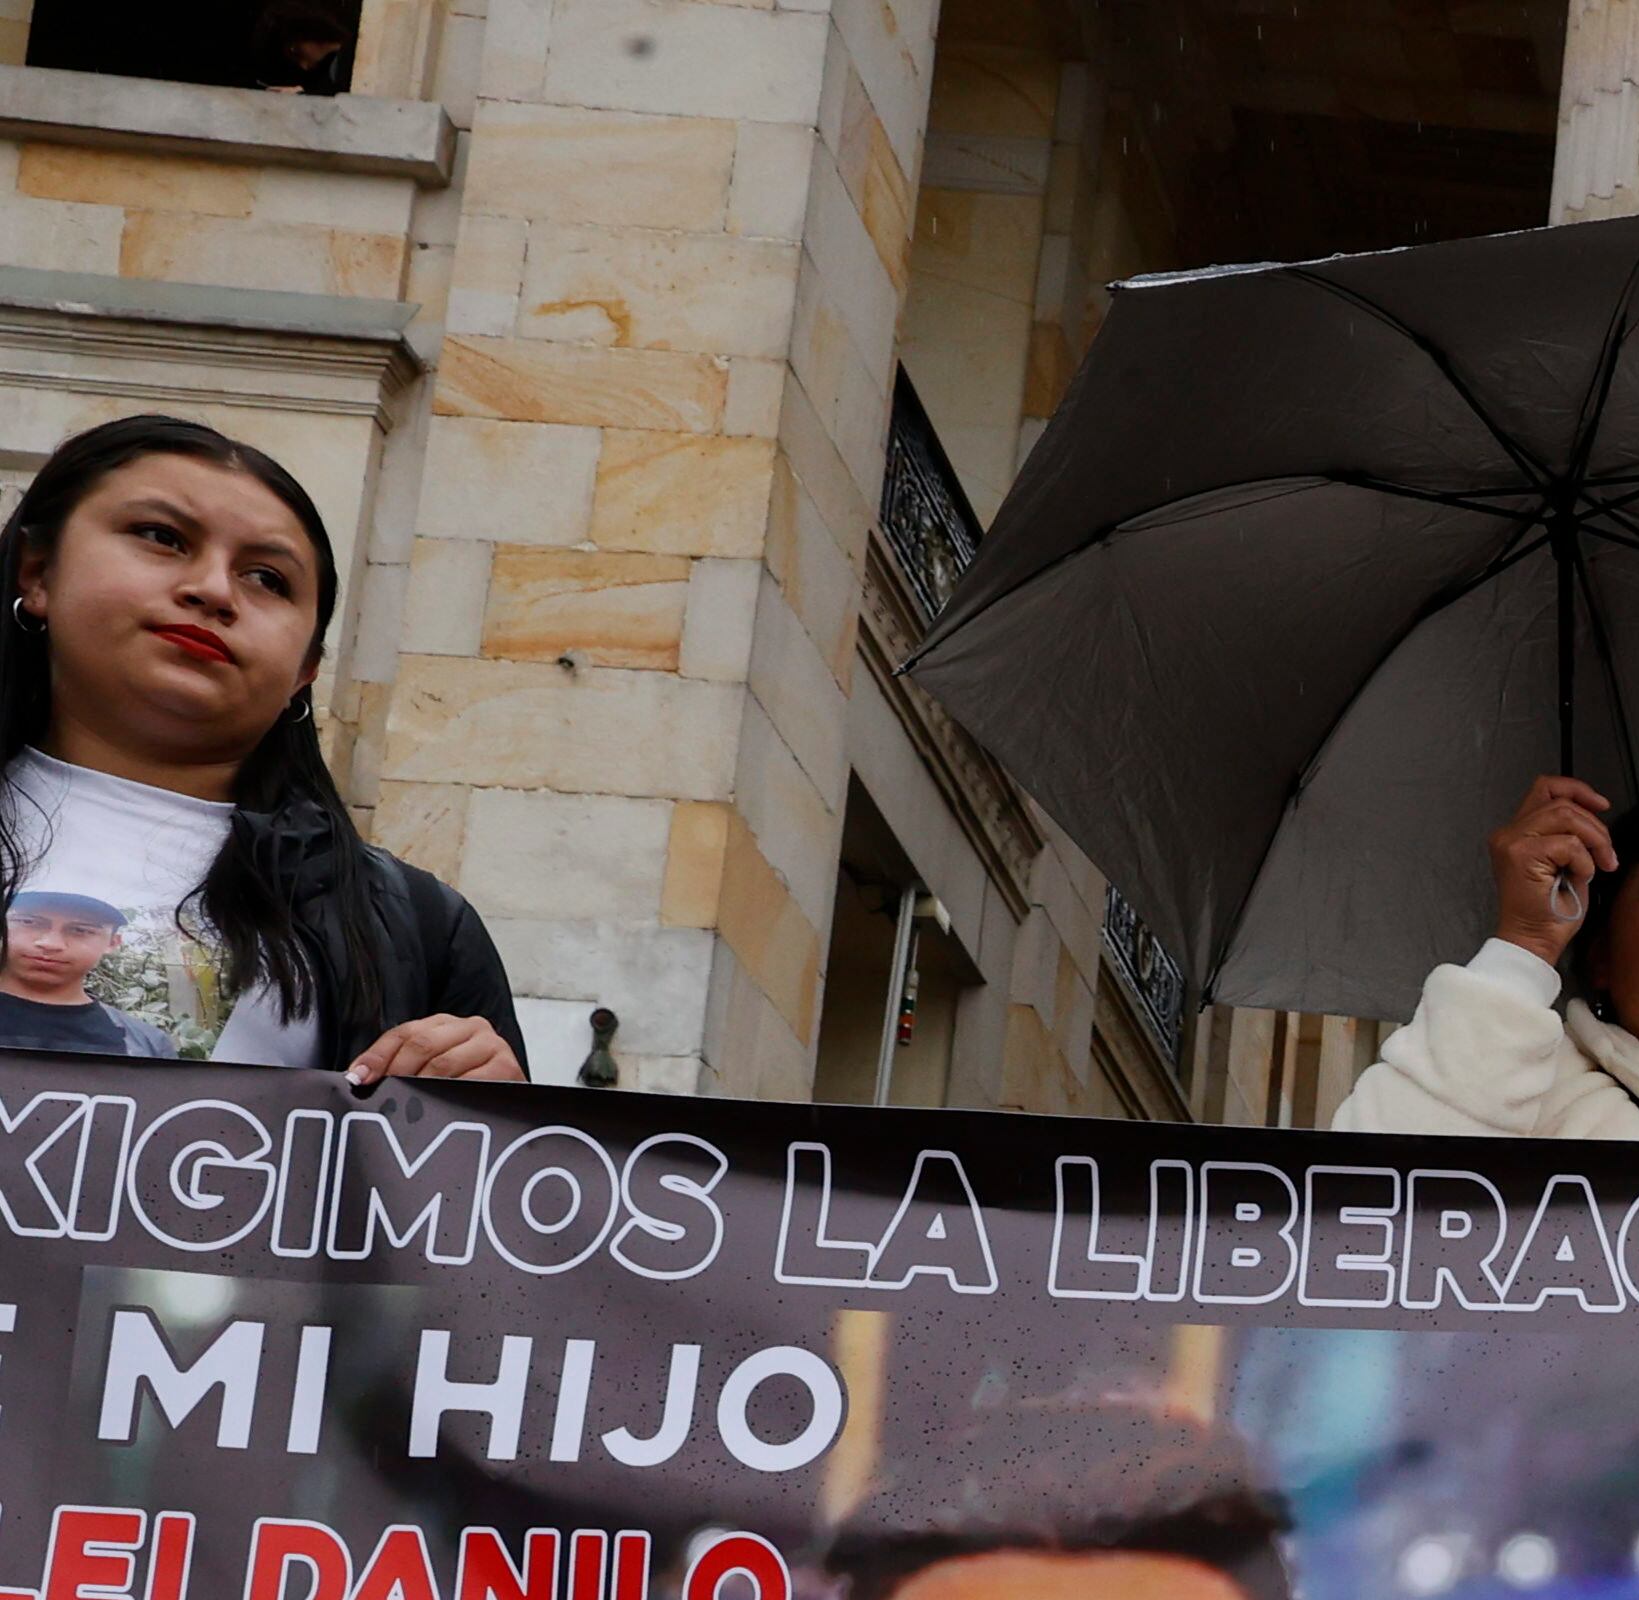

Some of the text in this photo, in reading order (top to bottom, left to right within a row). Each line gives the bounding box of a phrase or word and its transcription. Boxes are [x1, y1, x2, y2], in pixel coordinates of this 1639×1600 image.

[773, 1142, 999, 1295] LA
[98, 1311, 332, 1455] MI
[408, 1328, 849, 1473] HIJO
